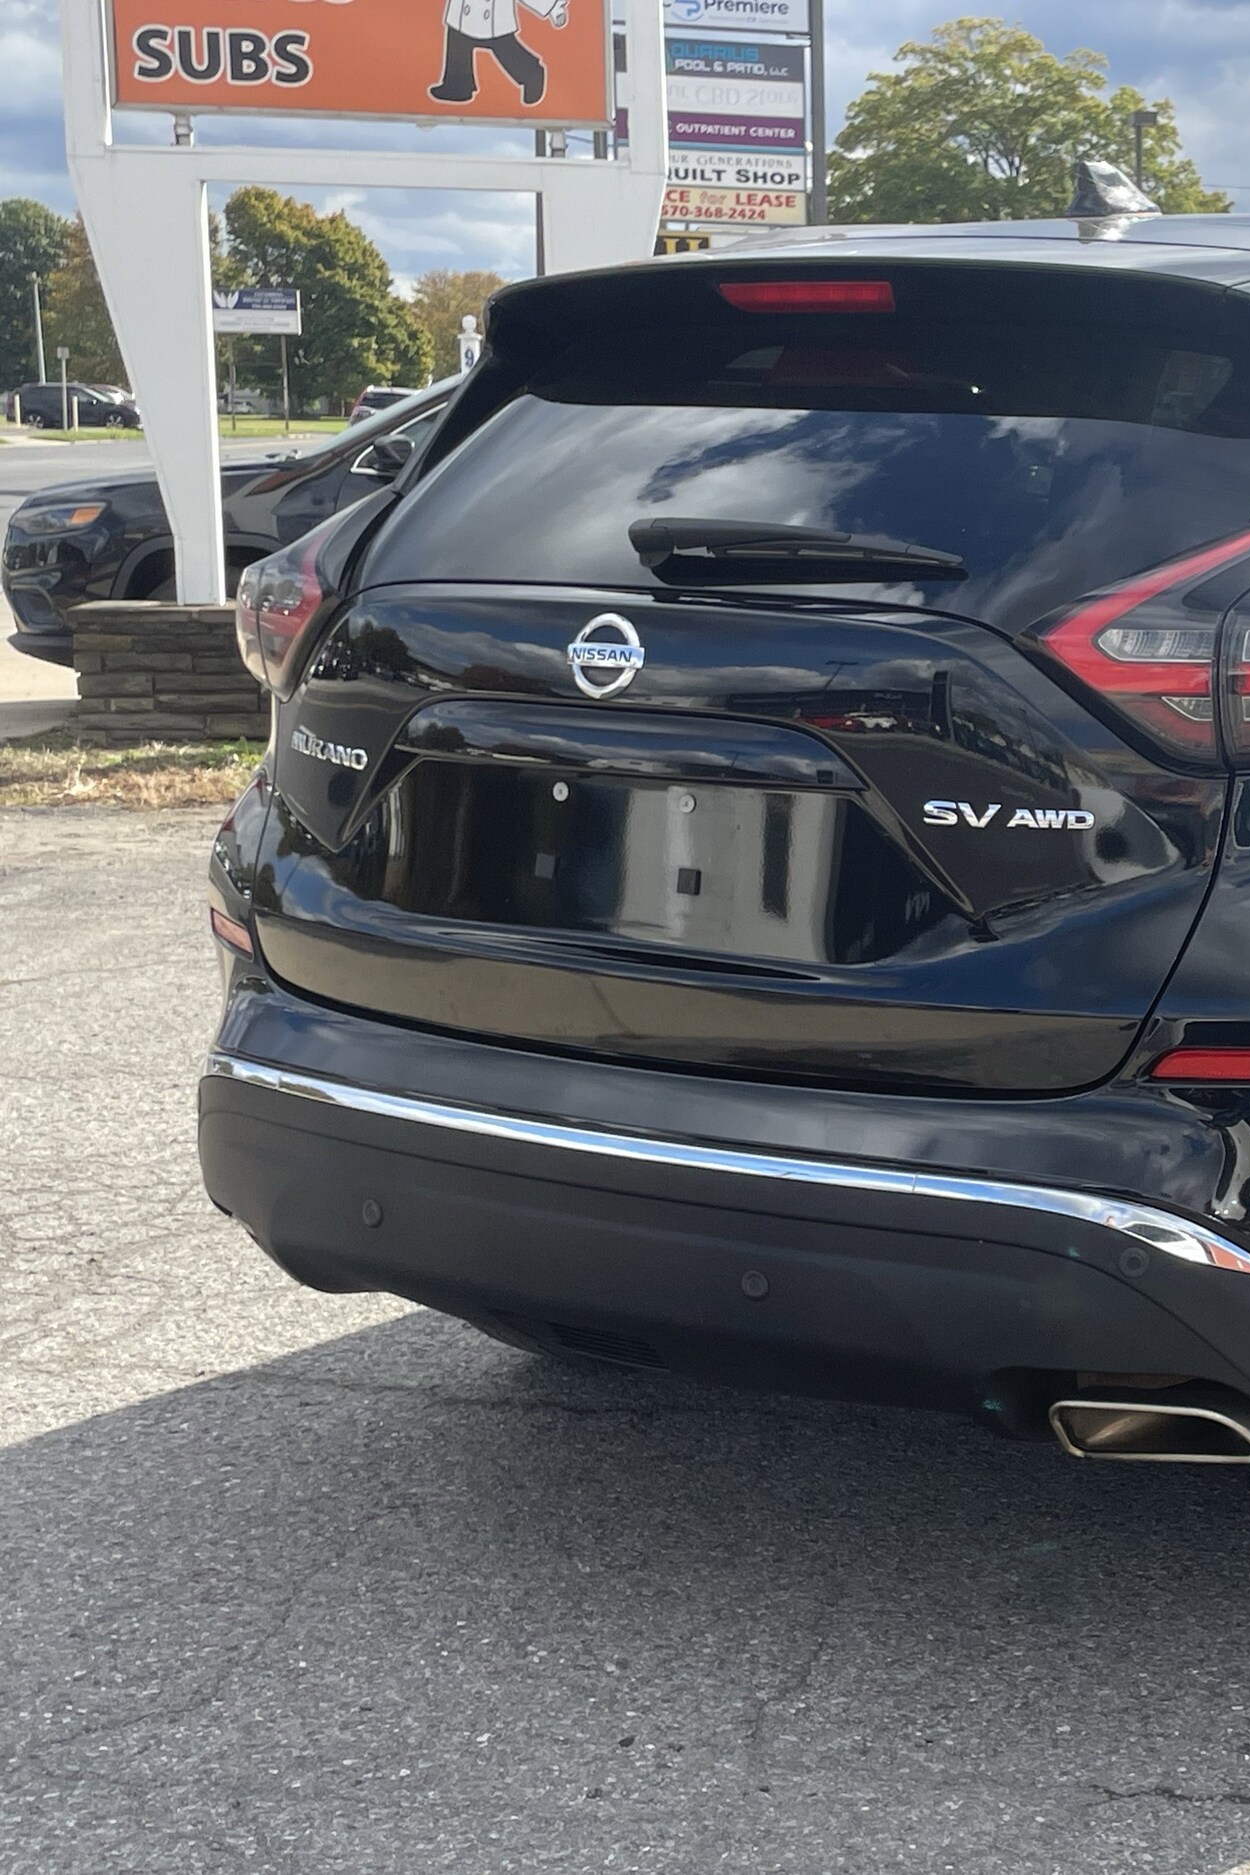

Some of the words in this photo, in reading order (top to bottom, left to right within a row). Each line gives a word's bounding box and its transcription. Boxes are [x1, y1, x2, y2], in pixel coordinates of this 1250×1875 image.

[704, 0, 789, 15] Premiere
[133, 25, 312, 86] SUBS
[674, 59, 711, 73] POOL
[713, 61, 723, 73] &
[726, 62, 768, 76] PATIO,
[769, 67, 788, 76] LLC
[676, 122, 747, 136] OUTPATIENT
[749, 126, 796, 139] CENTER
[667, 154, 689, 165] UR
[696, 156, 793, 169] GENERATIONS
[735, 169, 801, 185] SHOP
[700, 191, 727, 205] for
[735, 193, 797, 208] LEASE
[464, 346, 474, 368] 9
[571, 647, 633, 663] NISSAN
[291, 729, 369, 771] MURANO
[923, 800, 1002, 829] SV
[1006, 808, 1096, 831] AWD
